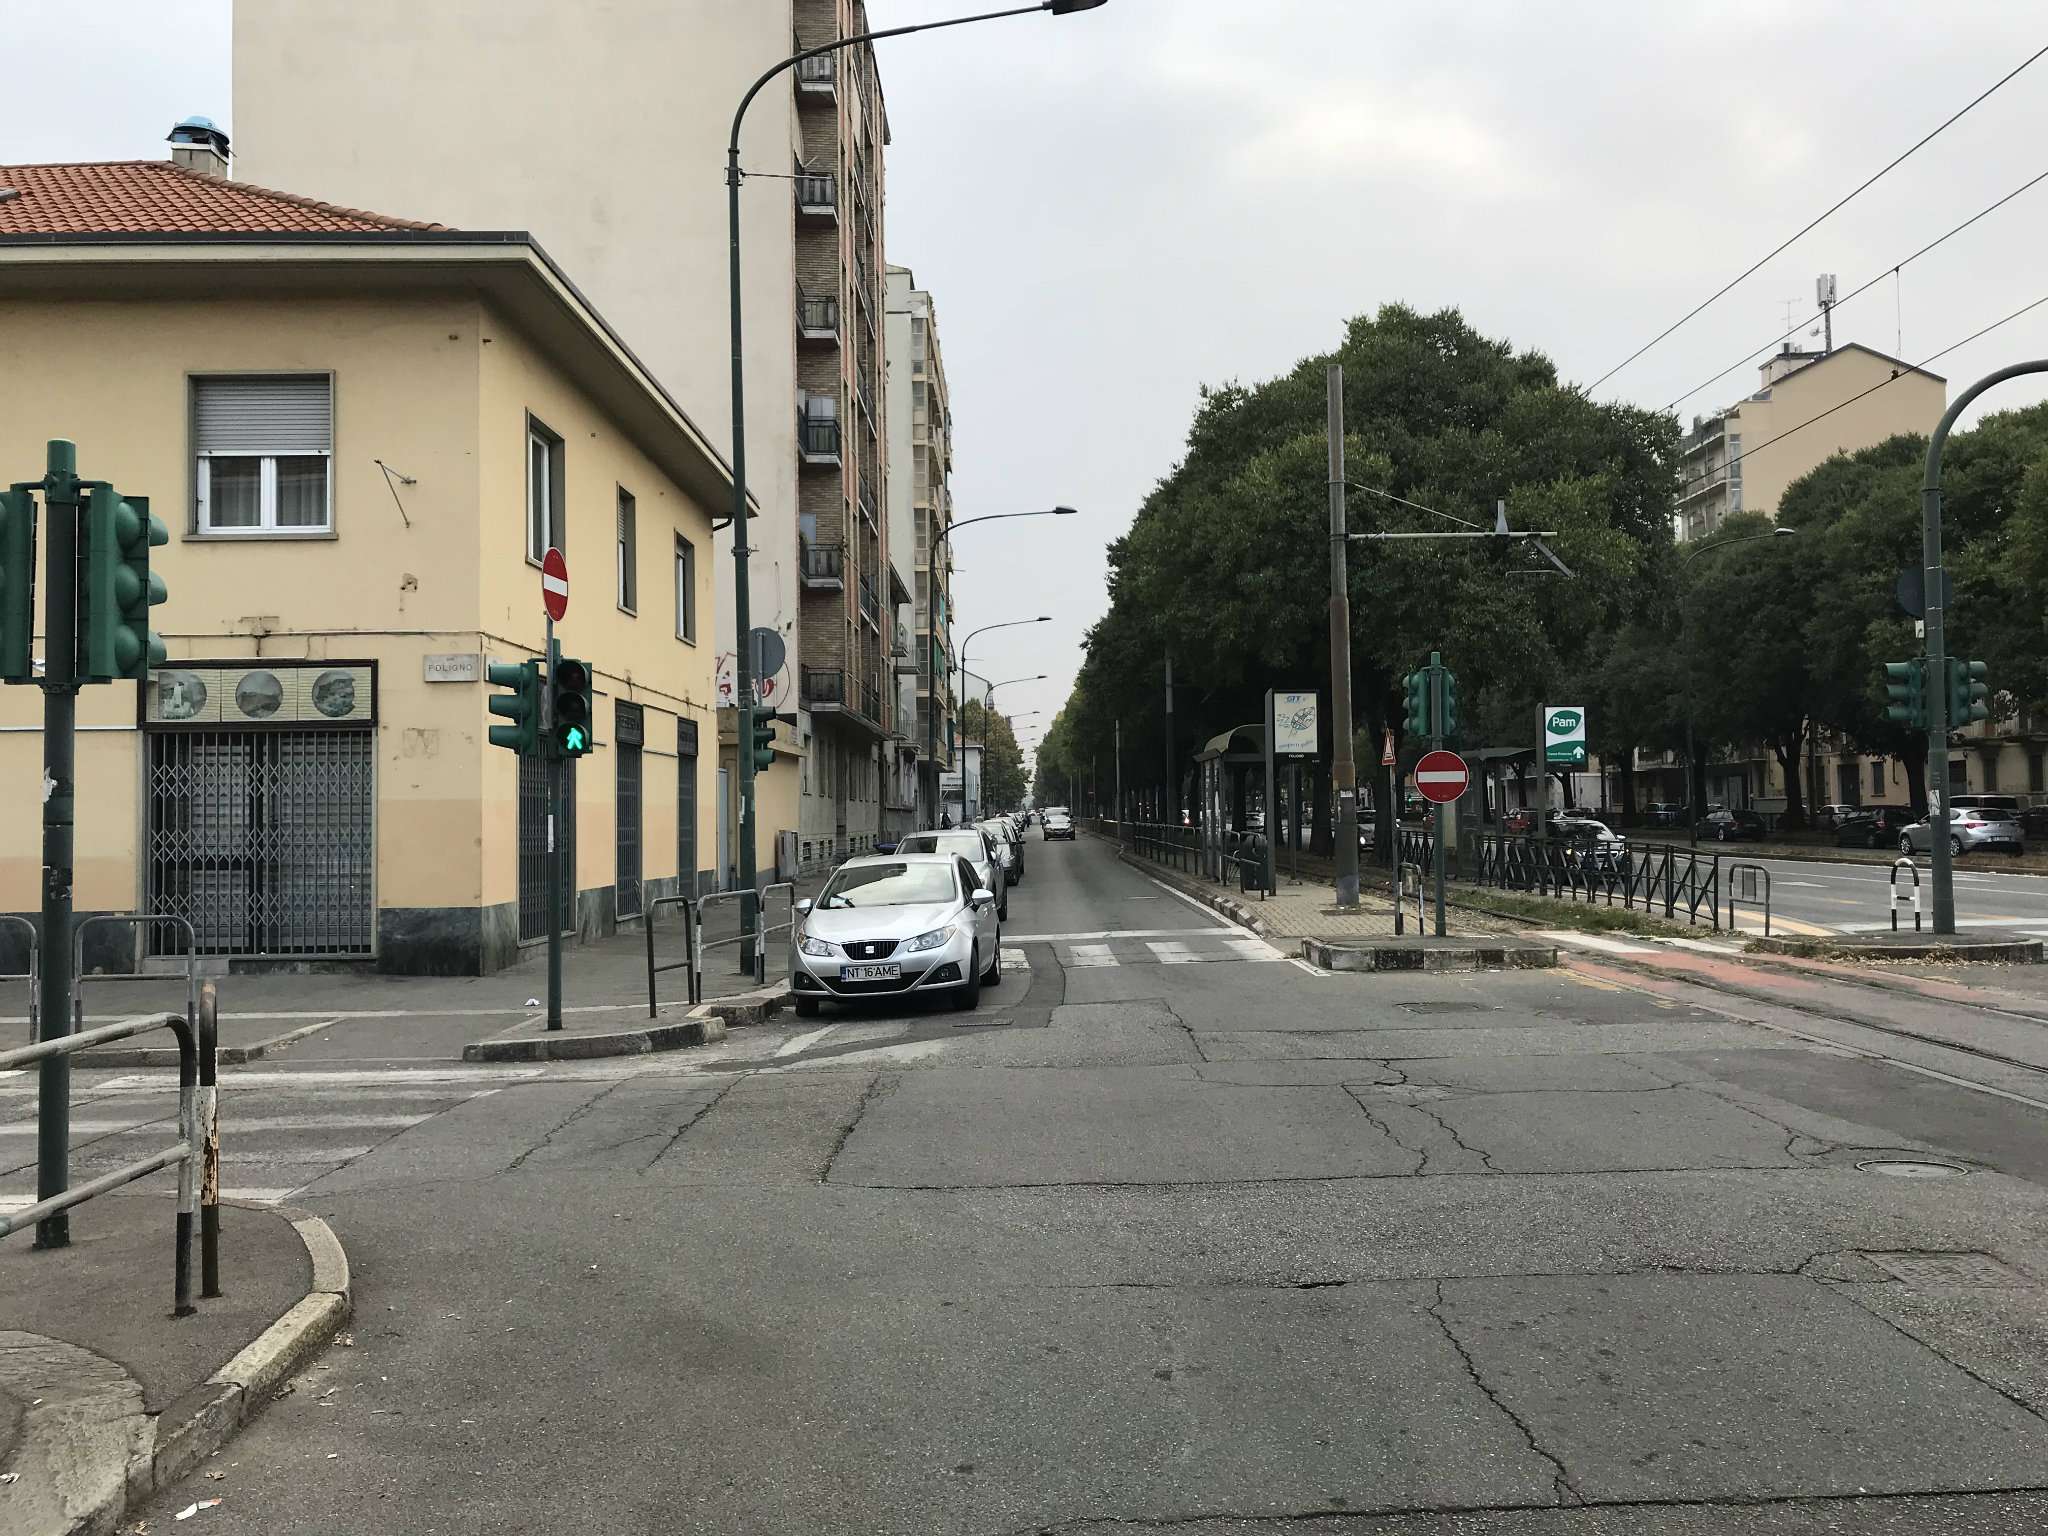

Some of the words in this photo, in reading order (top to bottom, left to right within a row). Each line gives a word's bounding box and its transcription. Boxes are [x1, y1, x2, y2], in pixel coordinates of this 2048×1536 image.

[428, 664, 473, 672] FOLIGNO
[1552, 716, 1576, 727] Pam
[847, 967, 860, 978] NT
[863, 967, 874, 977] 16
[874, 965, 899, 977] AME
